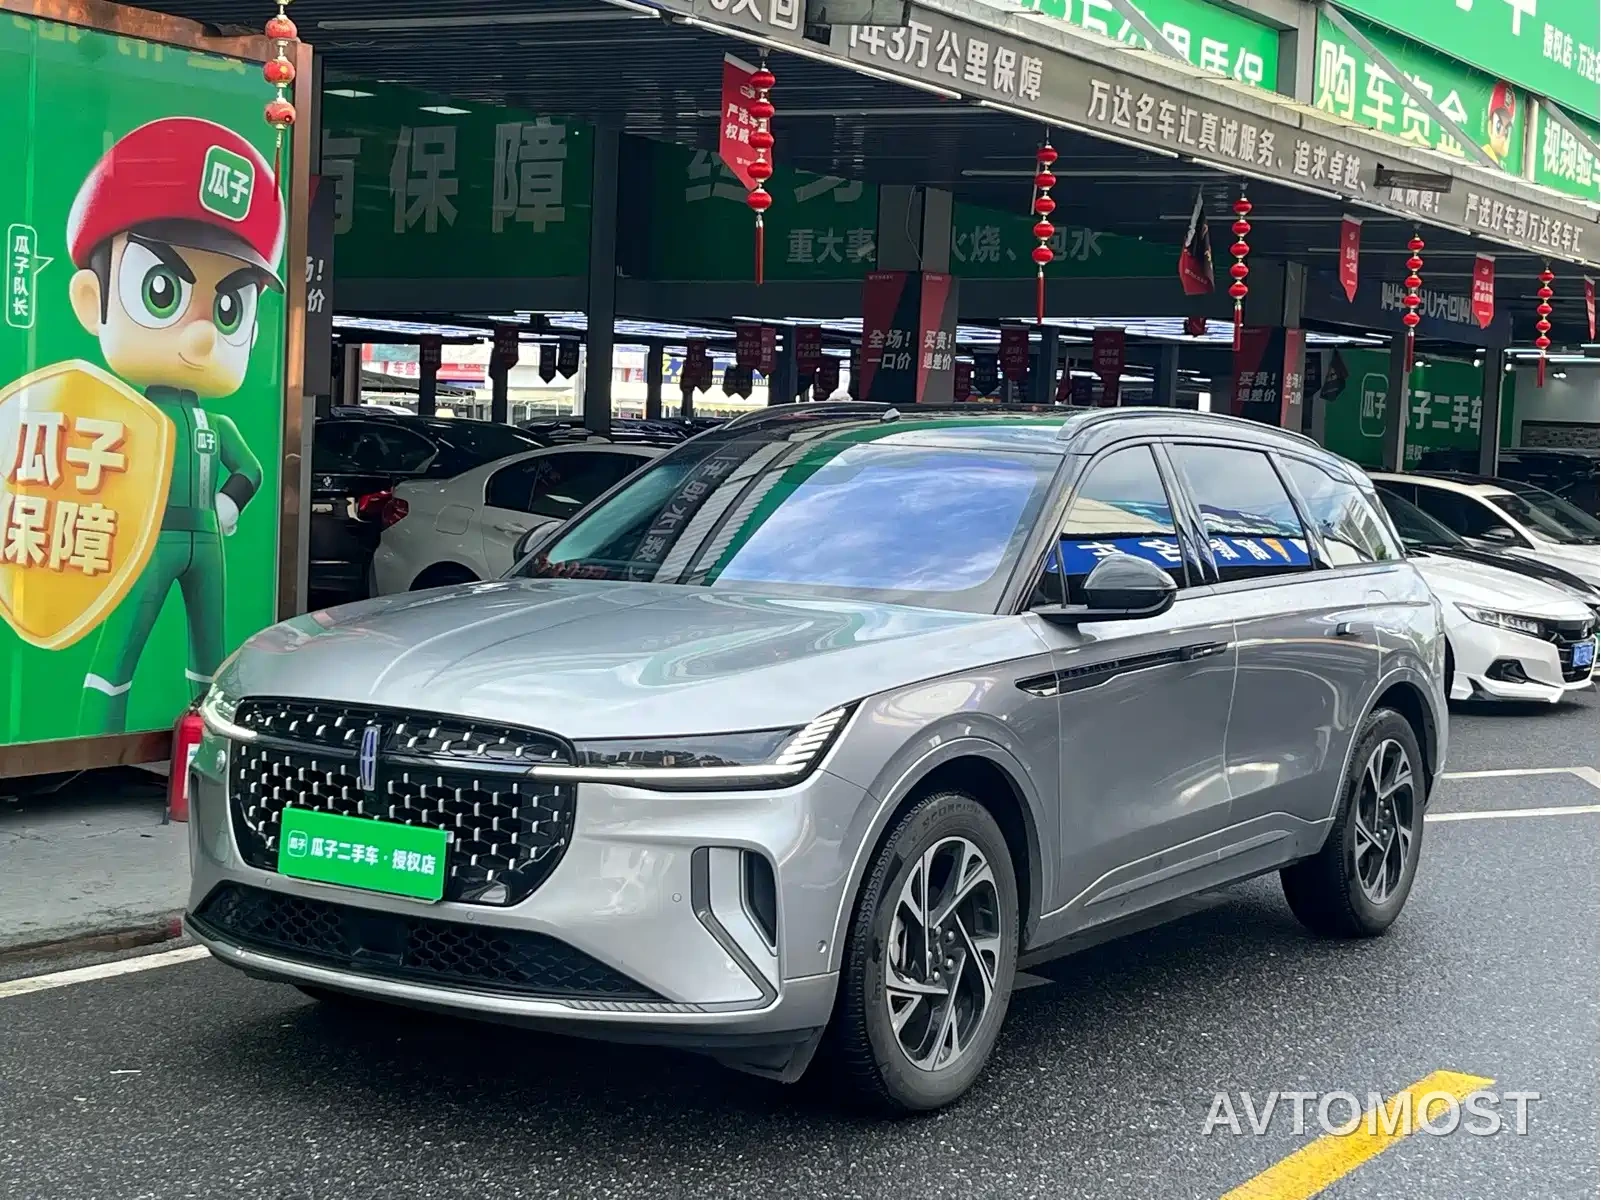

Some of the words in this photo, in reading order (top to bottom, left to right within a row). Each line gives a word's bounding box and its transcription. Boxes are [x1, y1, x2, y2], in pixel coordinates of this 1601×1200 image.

[208, 162, 250, 204] 瓜子
[1464, 192, 1583, 253] 严选好车到万达名车汇
[13, 235, 29, 316] 瓜子队长
[867, 353, 911, 370] 一口价
[1363, 391, 1386, 419] 瓜子
[5, 412, 128, 494] 瓜子
[198, 432, 215, 450] 瓜子
[0, 492, 119, 577] 保障
[289, 837, 306, 851] 瓜子
